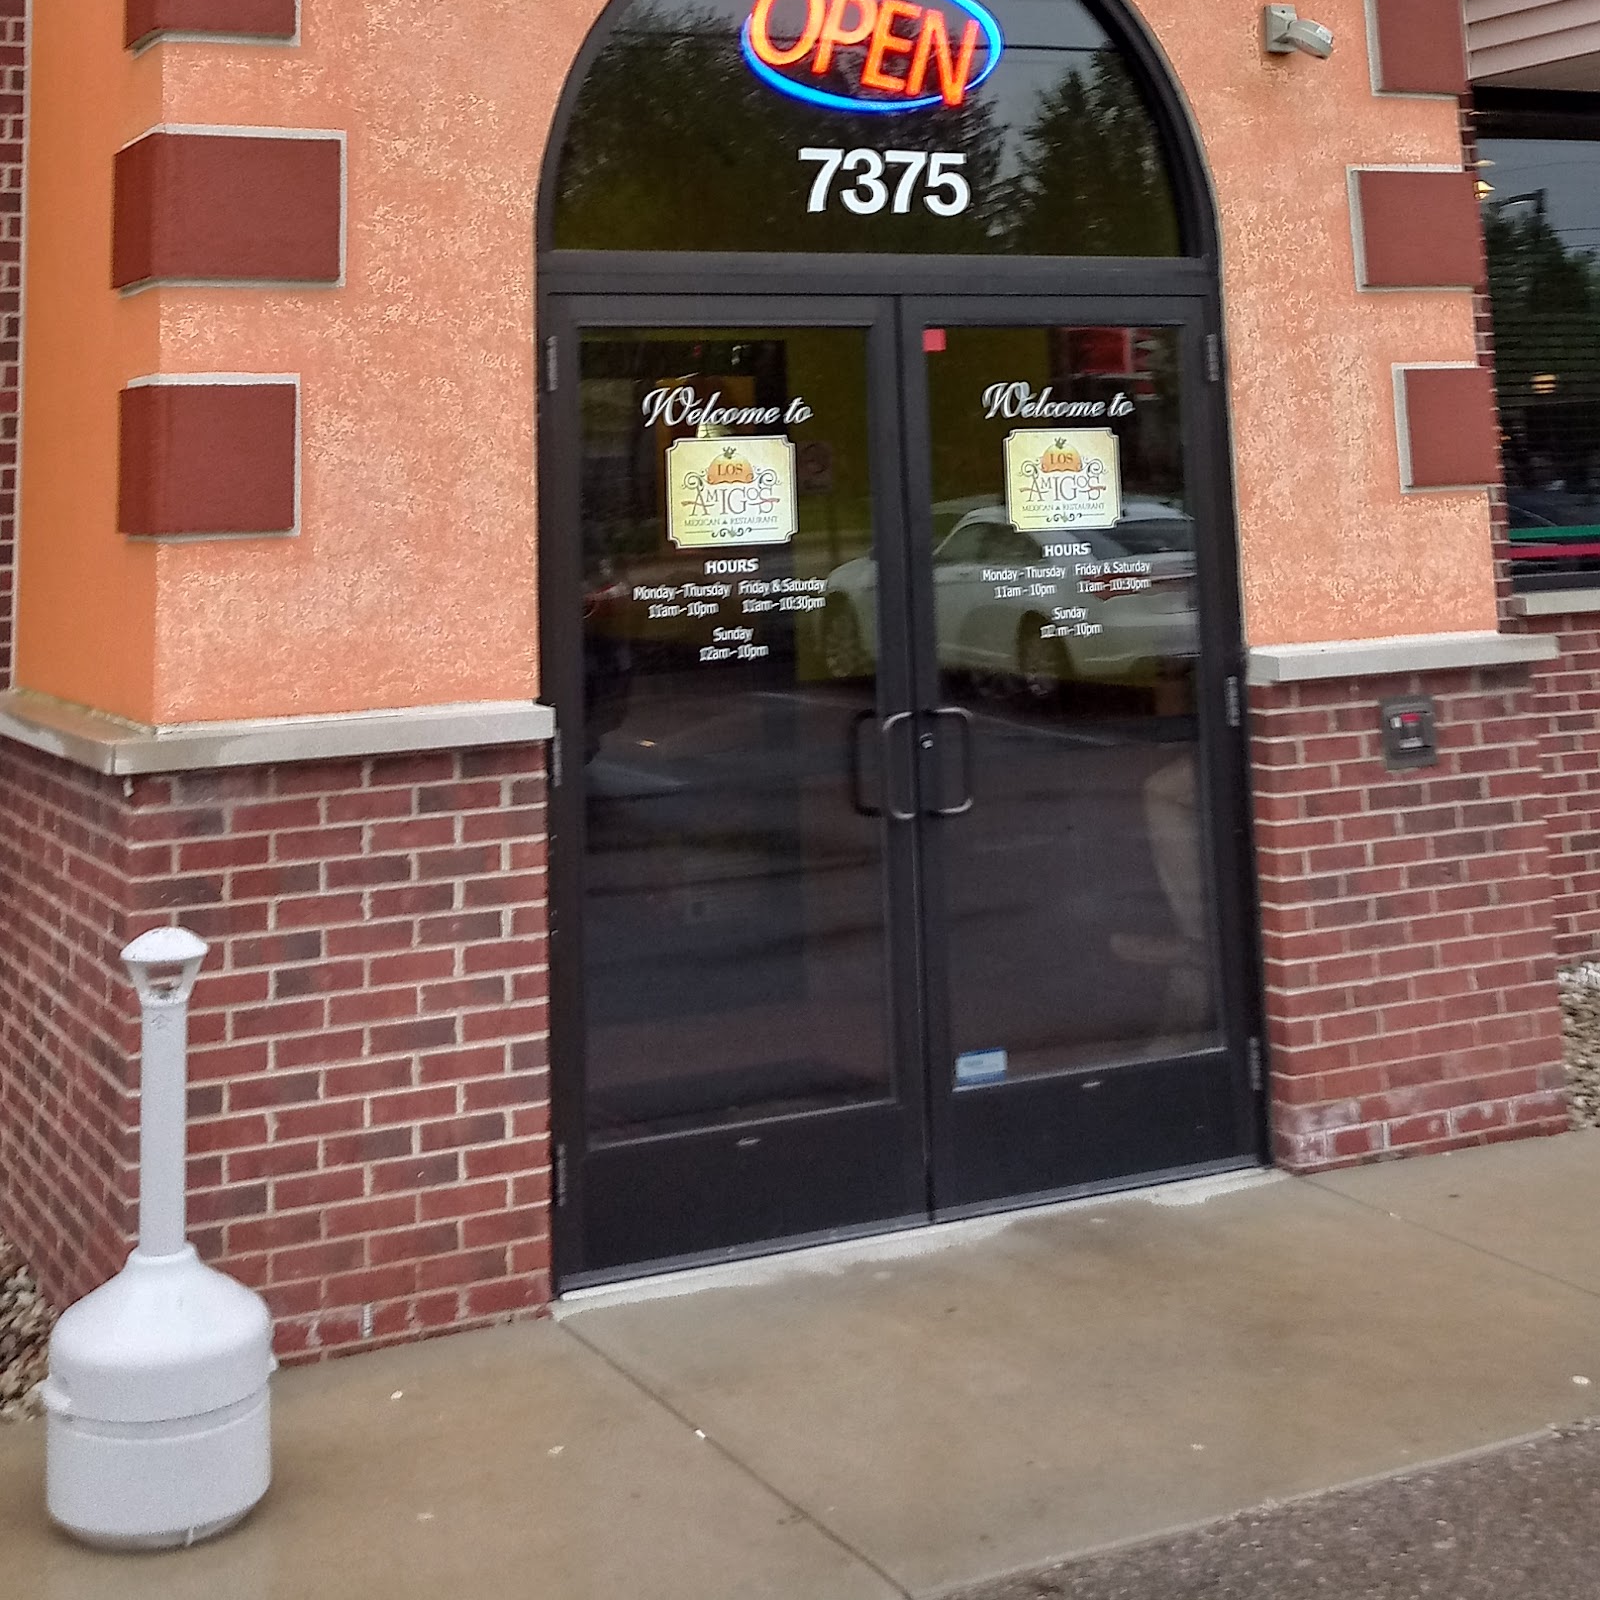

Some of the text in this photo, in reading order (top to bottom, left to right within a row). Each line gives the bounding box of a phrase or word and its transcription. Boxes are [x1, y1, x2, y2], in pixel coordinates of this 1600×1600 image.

[799, 148, 971, 216] 7375
[642, 386, 813, 427] Welcome to
[982, 381, 1136, 419] Welcome to
[1050, 453, 1073, 465] LOS
[718, 464, 743, 476] LOS
[1042, 542, 1092, 558] HOURS
[704, 558, 760, 575] HOURS
[1074, 560, 1151, 576] Friday & Saturday
[738, 577, 829, 596] Friday & Saturday
[1052, 606, 1088, 621] Sunday
[713, 626, 754, 642] Sunday
